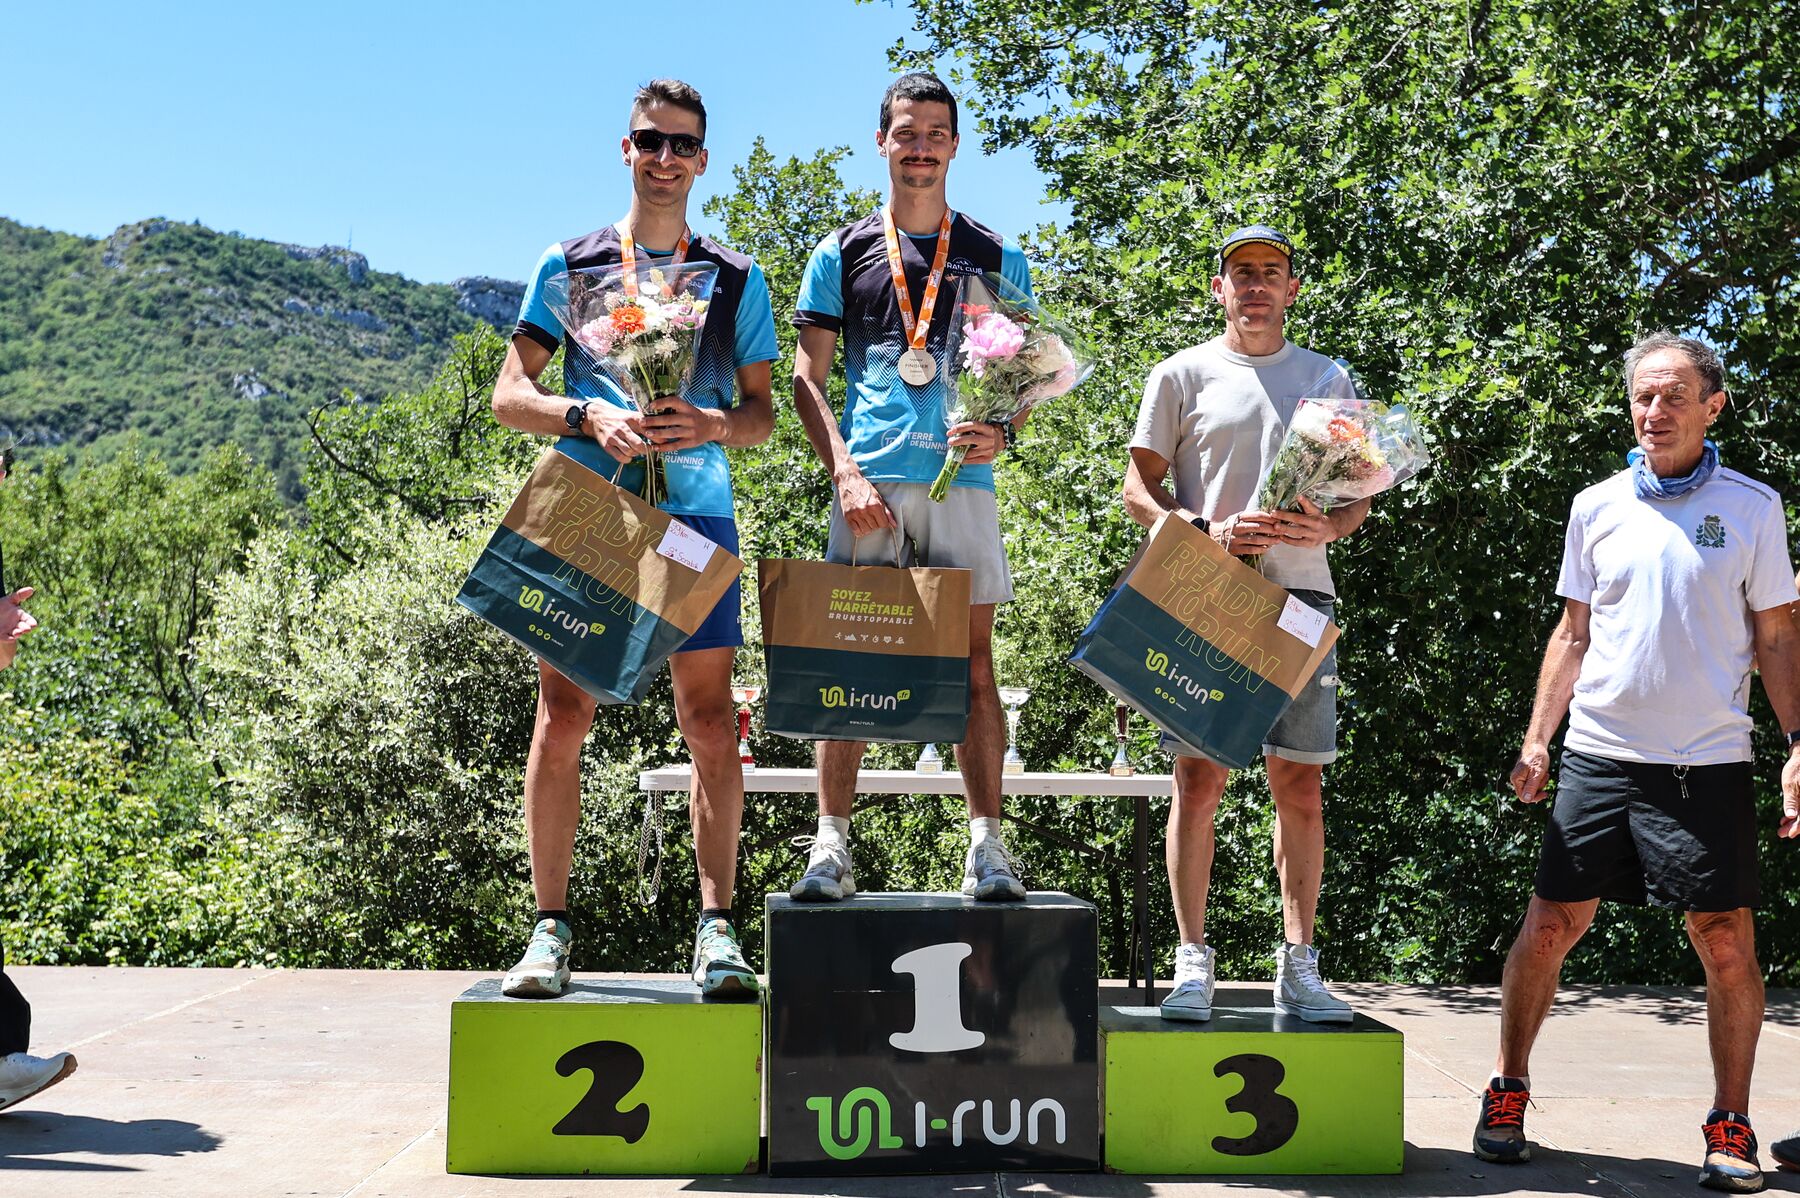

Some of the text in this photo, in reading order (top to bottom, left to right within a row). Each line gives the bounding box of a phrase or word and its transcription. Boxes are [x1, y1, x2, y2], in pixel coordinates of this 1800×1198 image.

[965, 266, 983, 275] CLUB
[664, 455, 705, 465] RUNNING
[907, 432, 934, 441] TERRE
[537, 475, 663, 558] READY
[553, 542, 661, 624] RUN
[828, 613, 914, 625] #RUNSTOPPABLE
[829, 601, 914, 616] INARRÊTABLE
[831, 588, 872, 602] SOYEZ
[1162, 540, 1280, 629] READY
[1175, 609, 1281, 693] RUN
[889, 942, 985, 1052] 1
[552, 1040, 651, 1143] 2
[1210, 1053, 1300, 1156] 3
